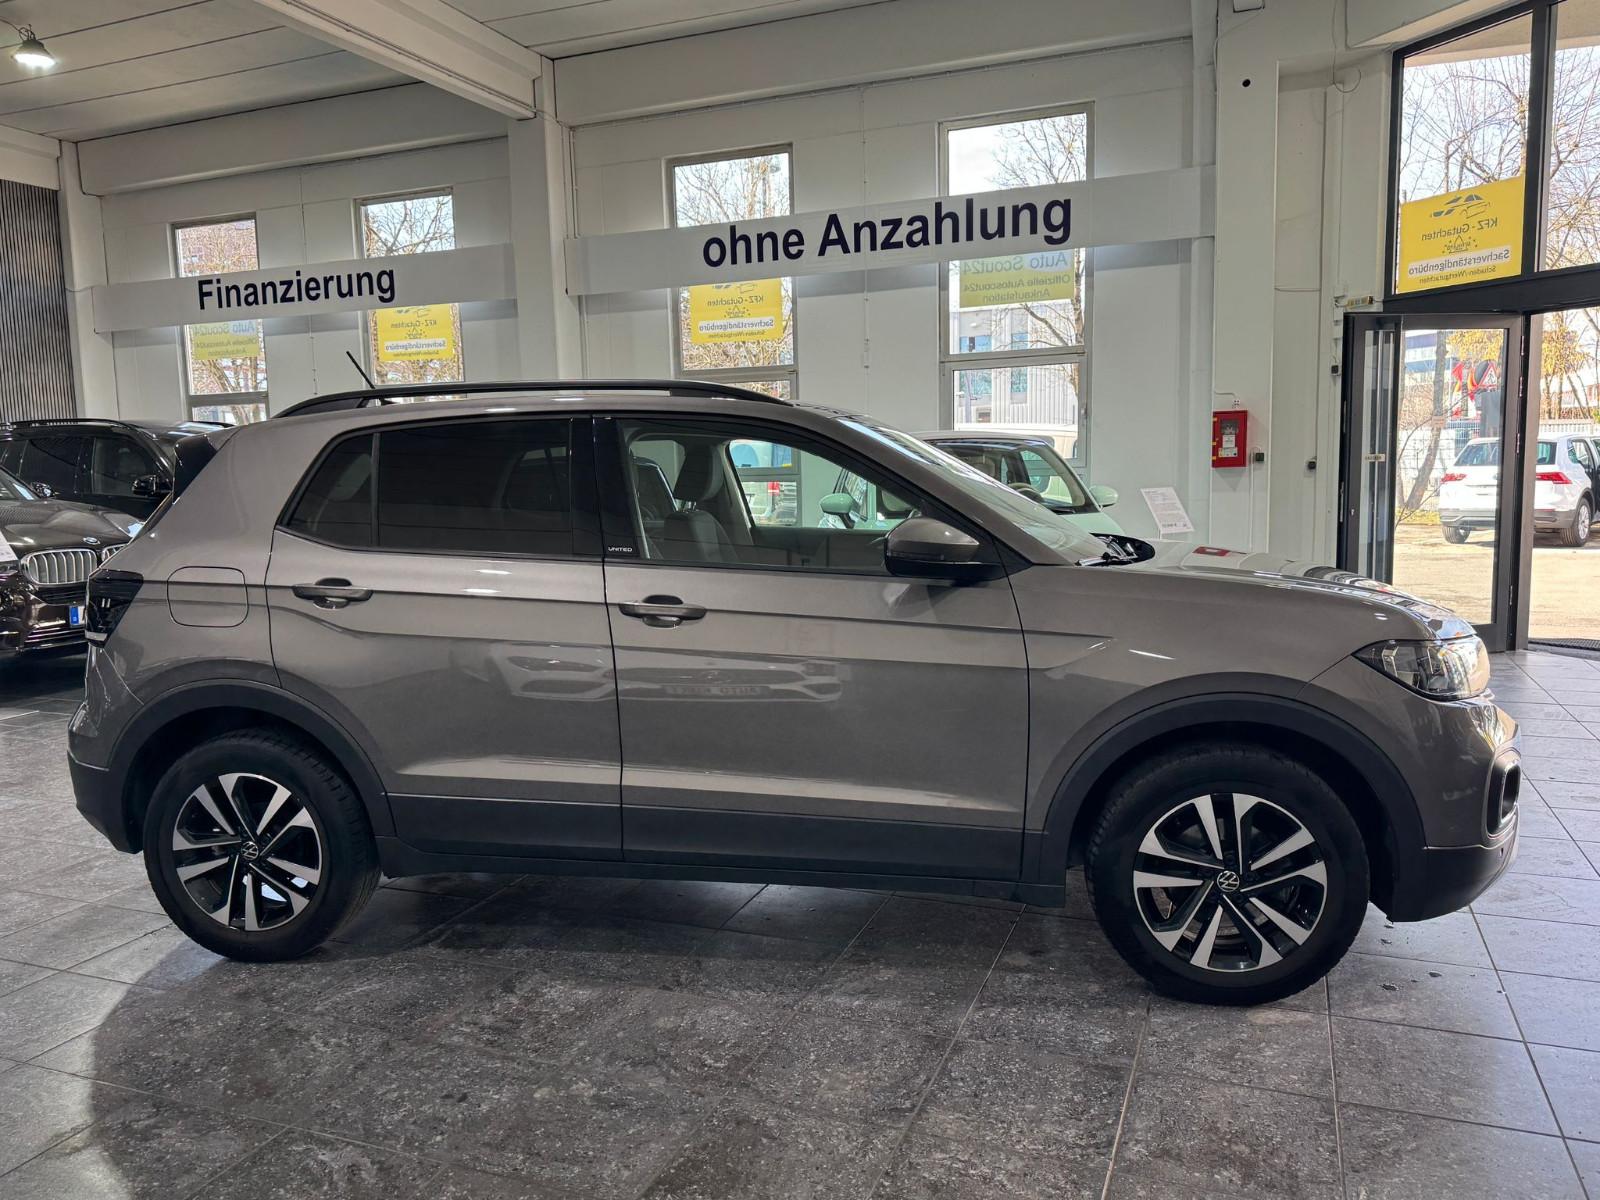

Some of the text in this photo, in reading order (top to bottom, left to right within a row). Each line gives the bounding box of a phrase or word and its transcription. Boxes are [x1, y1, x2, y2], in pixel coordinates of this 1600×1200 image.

[703, 198, 1071, 267] ohne Anzahlung
[198, 270, 395, 310] Finanzierung
